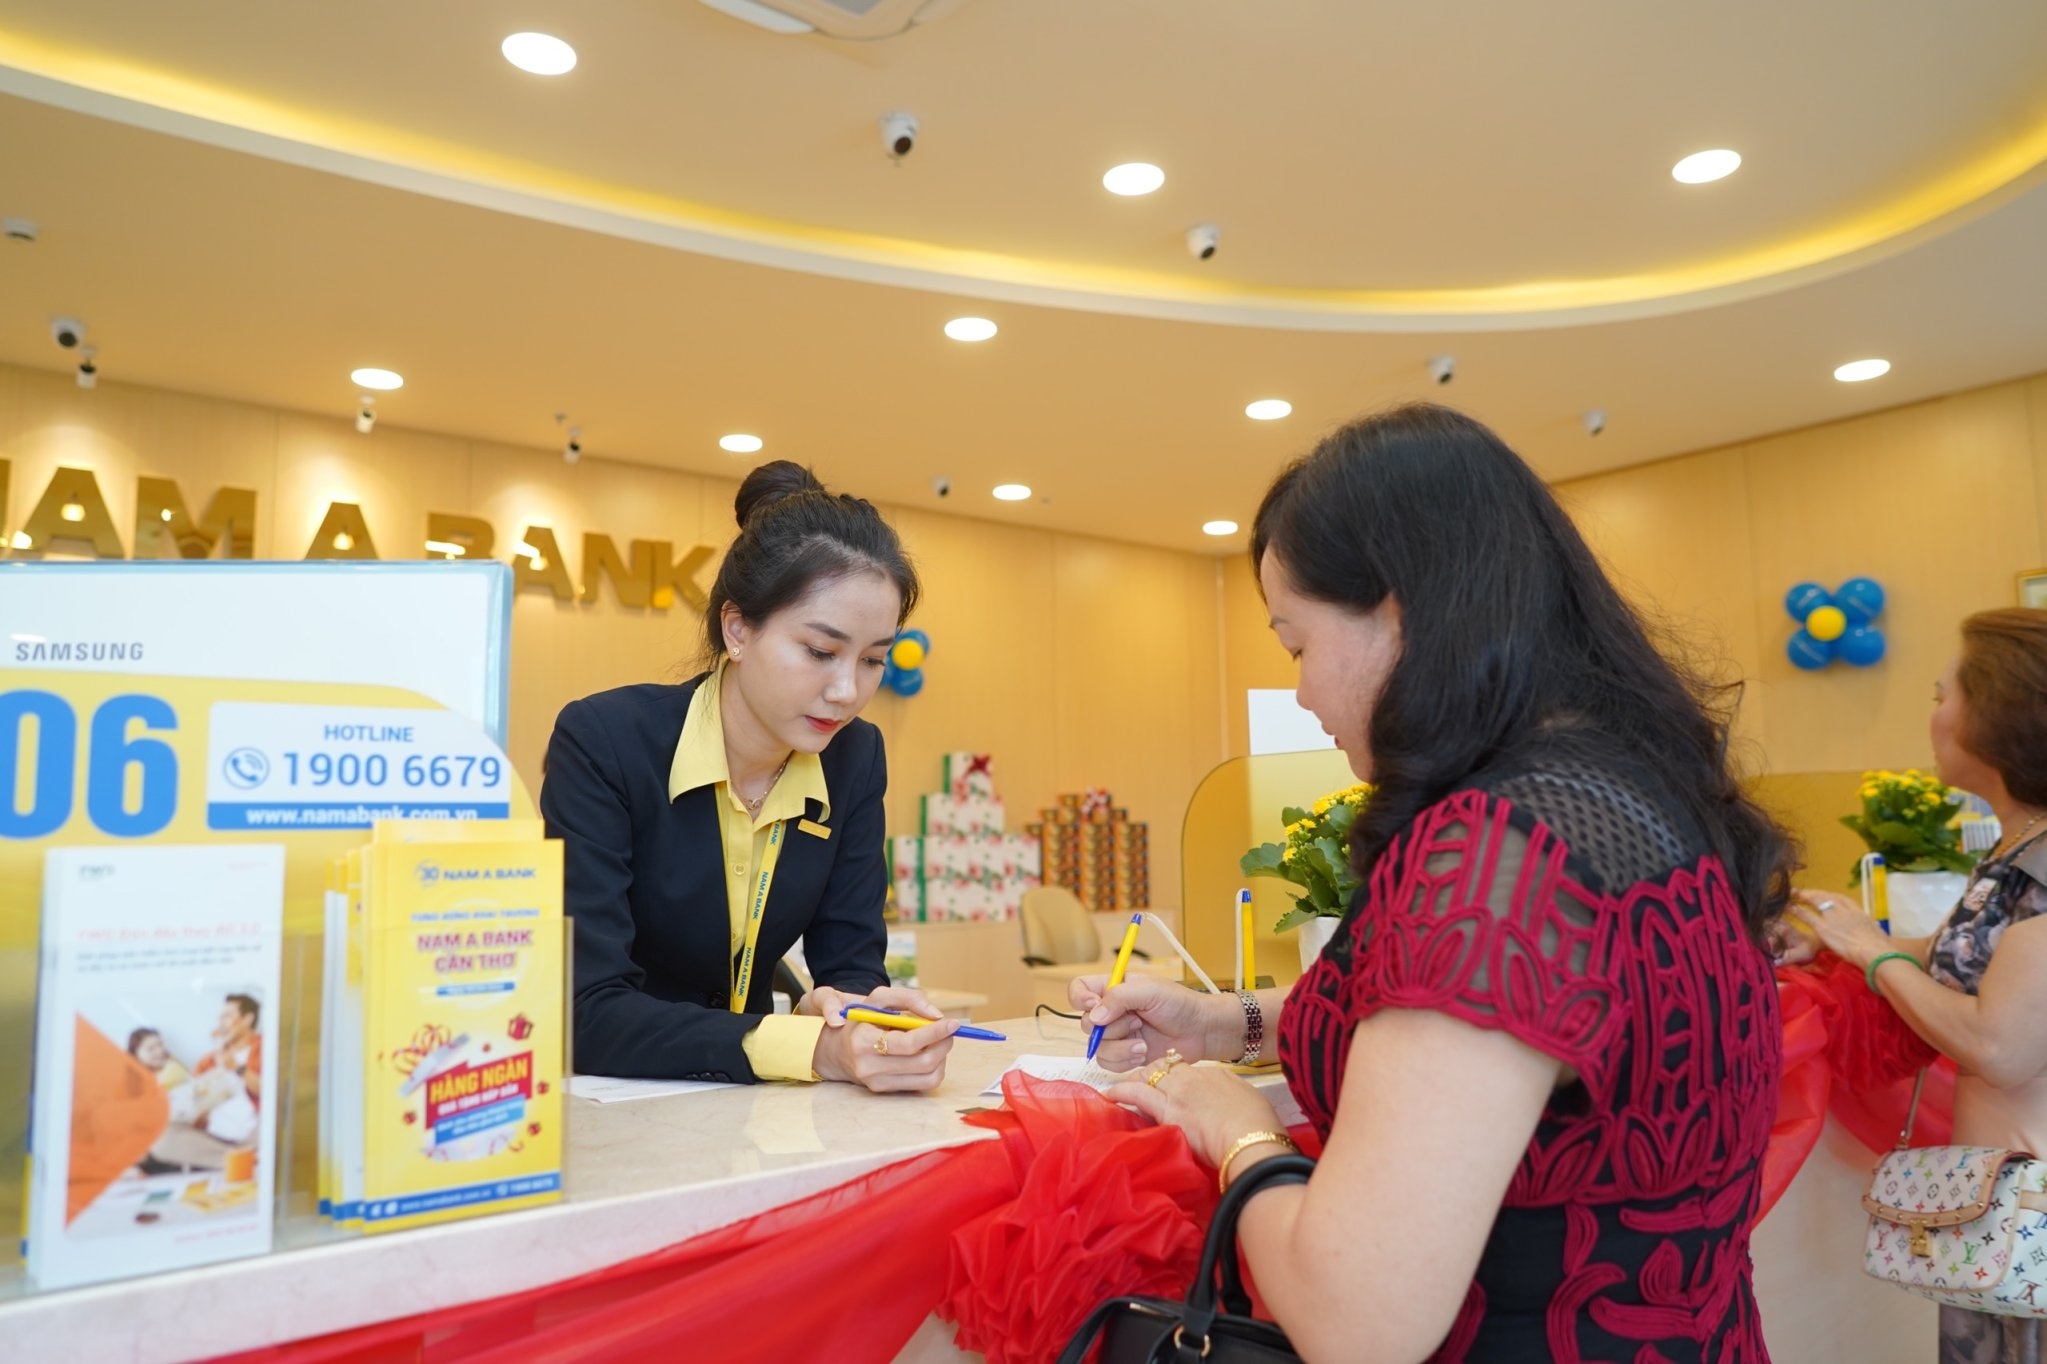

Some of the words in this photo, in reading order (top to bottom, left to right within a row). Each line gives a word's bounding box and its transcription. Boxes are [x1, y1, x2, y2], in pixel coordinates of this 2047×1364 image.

[0, 458, 258, 560] AM
[304, 502, 380, 560] A
[426, 512, 716, 611] BANK
[16, 642, 144, 661] SAMSUNG
[324, 724, 414, 742] HOTLINE
[284, 752, 388, 787] 1900
[403, 755, 501, 787] 6679
[246, 806, 478, 824] www.namabankcomvn
[443, 870, 479, 881] NAM
[483, 870, 492, 880] A
[495, 868, 536, 879] BANK
[759, 871, 768, 890] NAM
[753, 898, 762, 919] BANK
[417, 933, 461, 951] NAM
[466, 932, 478, 948] A
[483, 929, 533, 947] BANK
[738, 974, 747, 997] BANK
[430, 1071, 480, 1105] HÀNG
[481, 1056, 528, 1089] NGÀN
